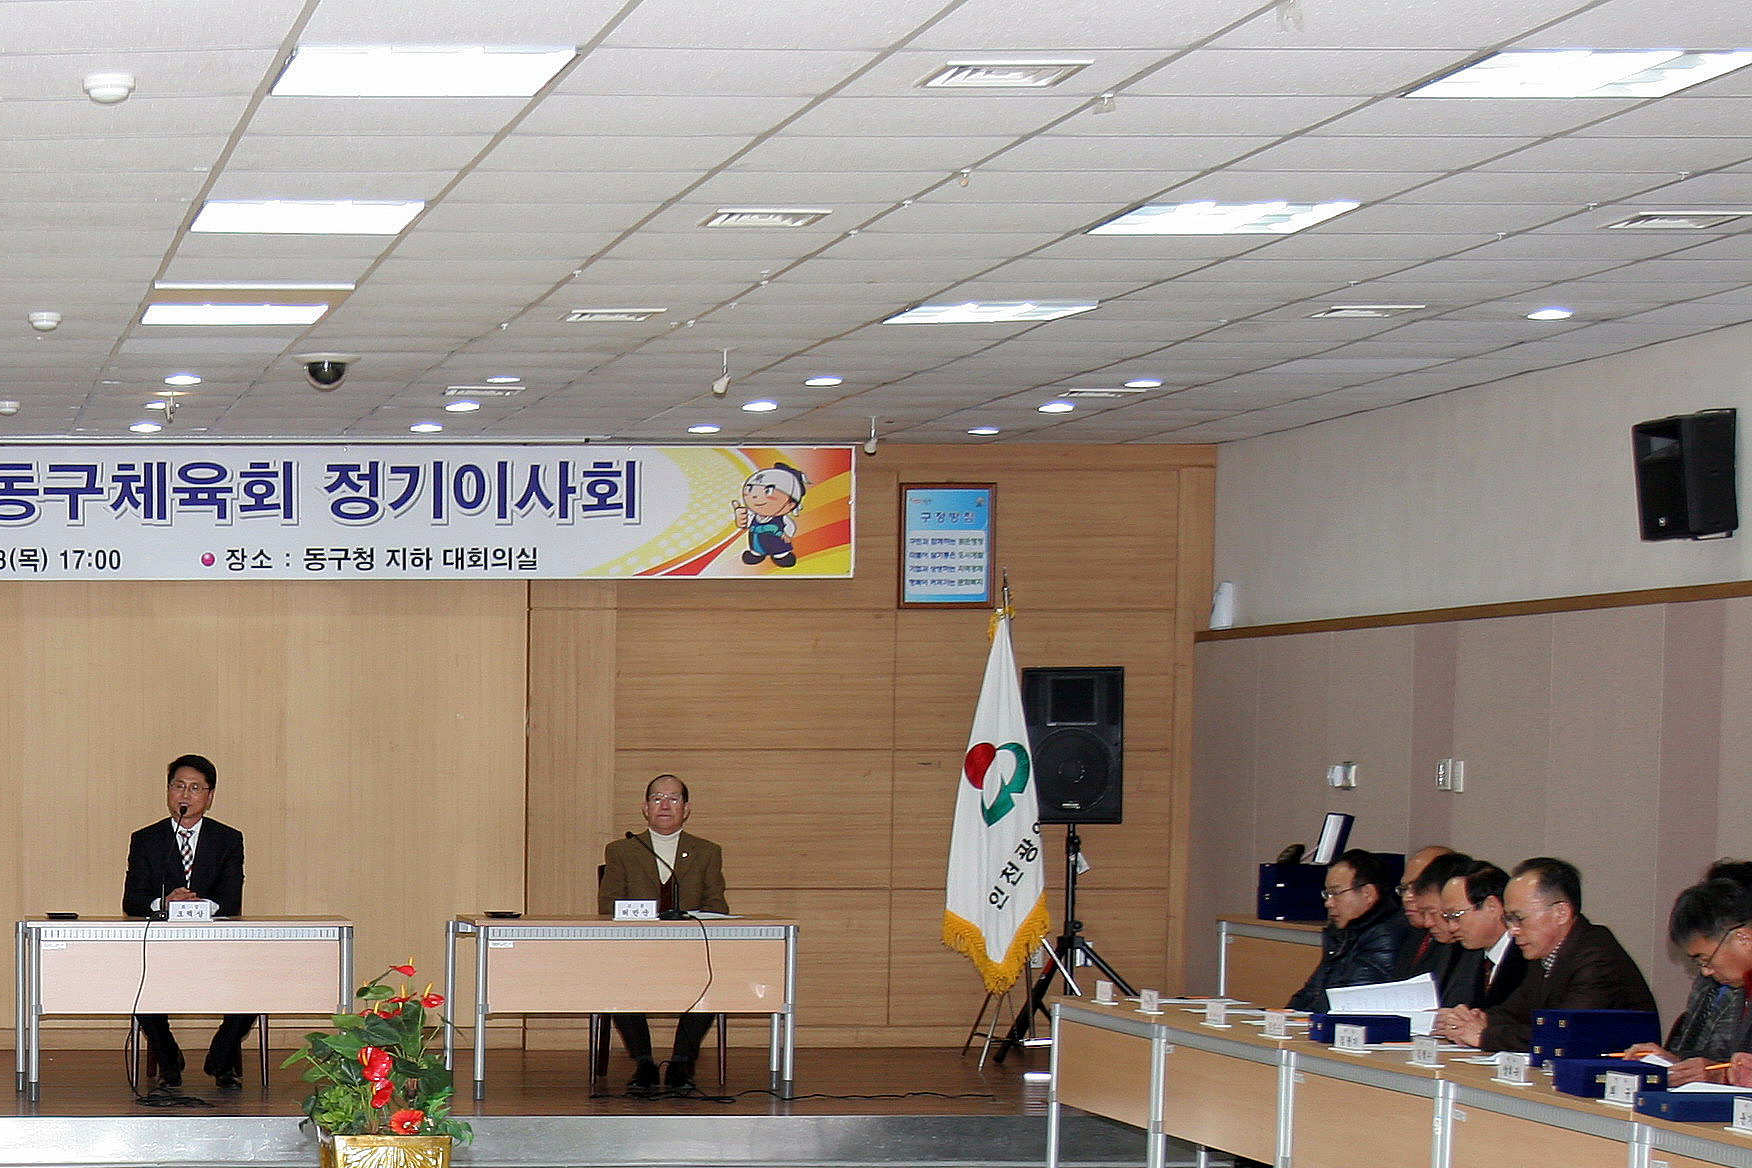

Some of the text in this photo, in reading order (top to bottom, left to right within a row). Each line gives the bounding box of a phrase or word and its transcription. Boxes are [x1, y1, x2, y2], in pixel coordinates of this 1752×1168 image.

[324, 459, 640, 522] 정기이사회
[59, 549, 121, 571] 17:00
[225, 548, 274, 572] 장소
[302, 547, 376, 572] 동구청
[386, 547, 433, 571] 지하
[442, 547, 538, 572] 대회의실
